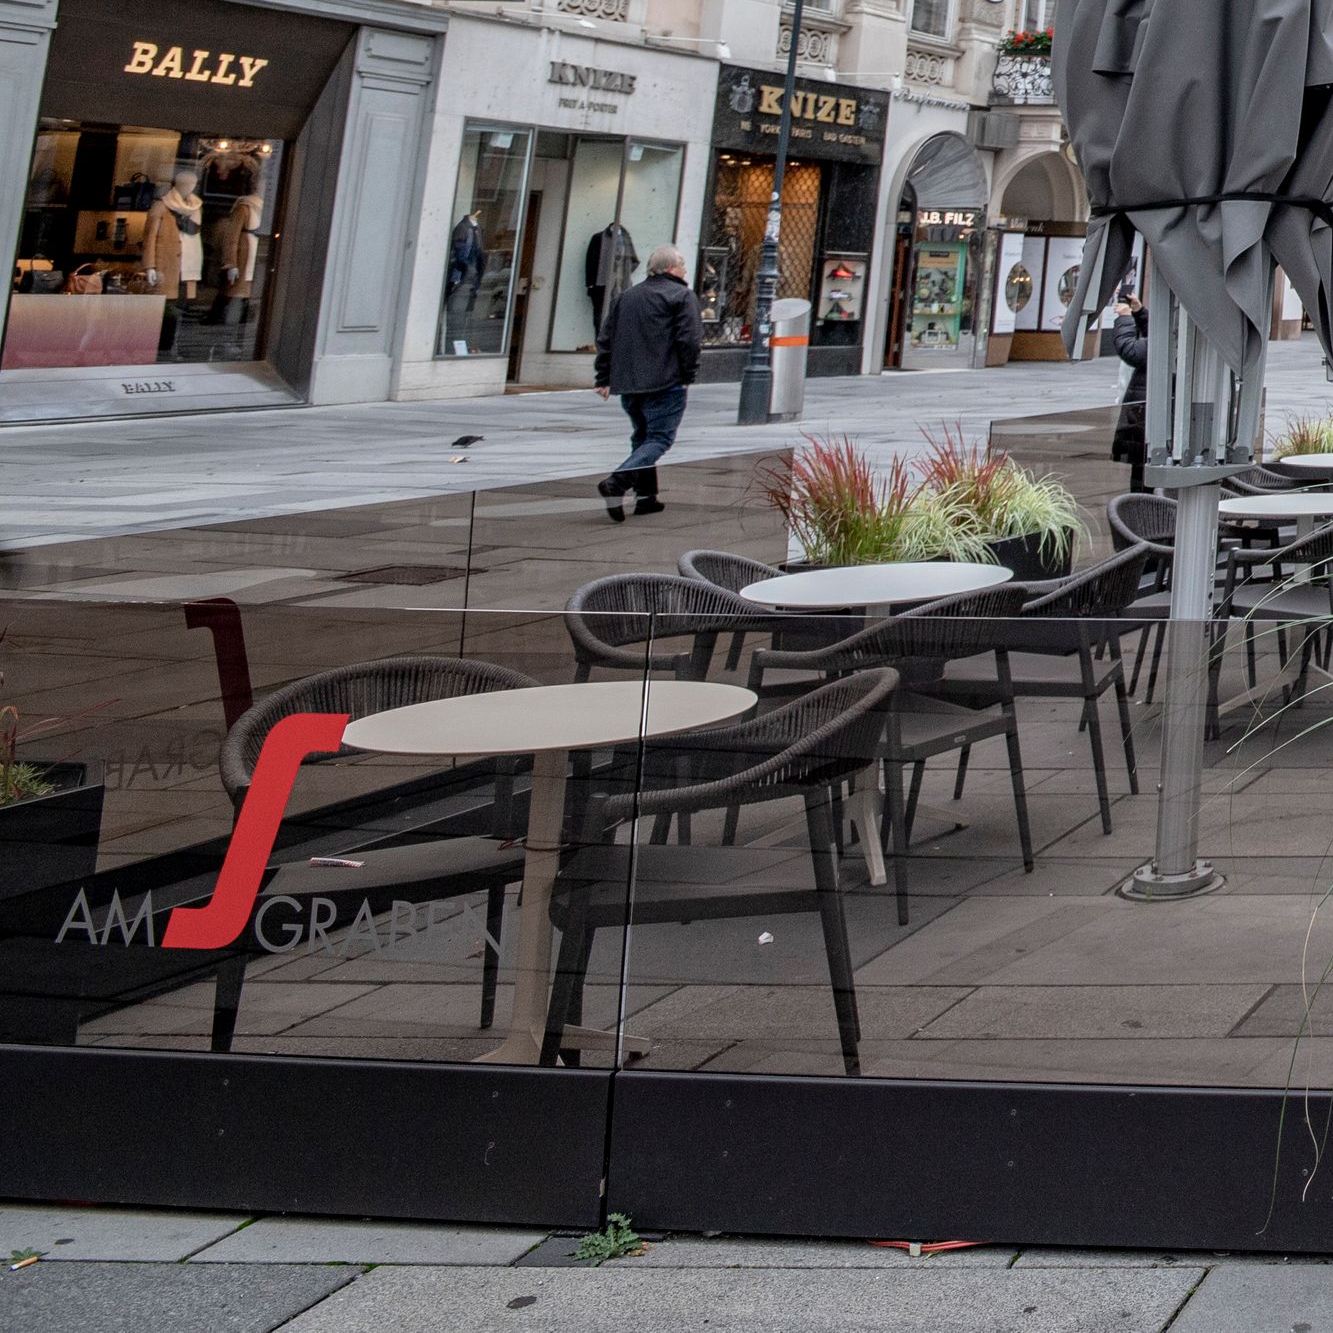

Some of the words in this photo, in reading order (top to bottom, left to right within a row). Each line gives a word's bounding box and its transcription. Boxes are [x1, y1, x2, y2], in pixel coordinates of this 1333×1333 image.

[124, 41, 269, 88] BALLY
[548, 59, 638, 95] KNIZE
[758, 84, 857, 126] KNIZE
[920, 211, 942, 224] J.B.
[943, 212, 975, 226] FILZ
[121, 381, 176, 395] BALLY
[55, 888, 155, 947] AM
[255, 895, 503, 958] GRABEN
